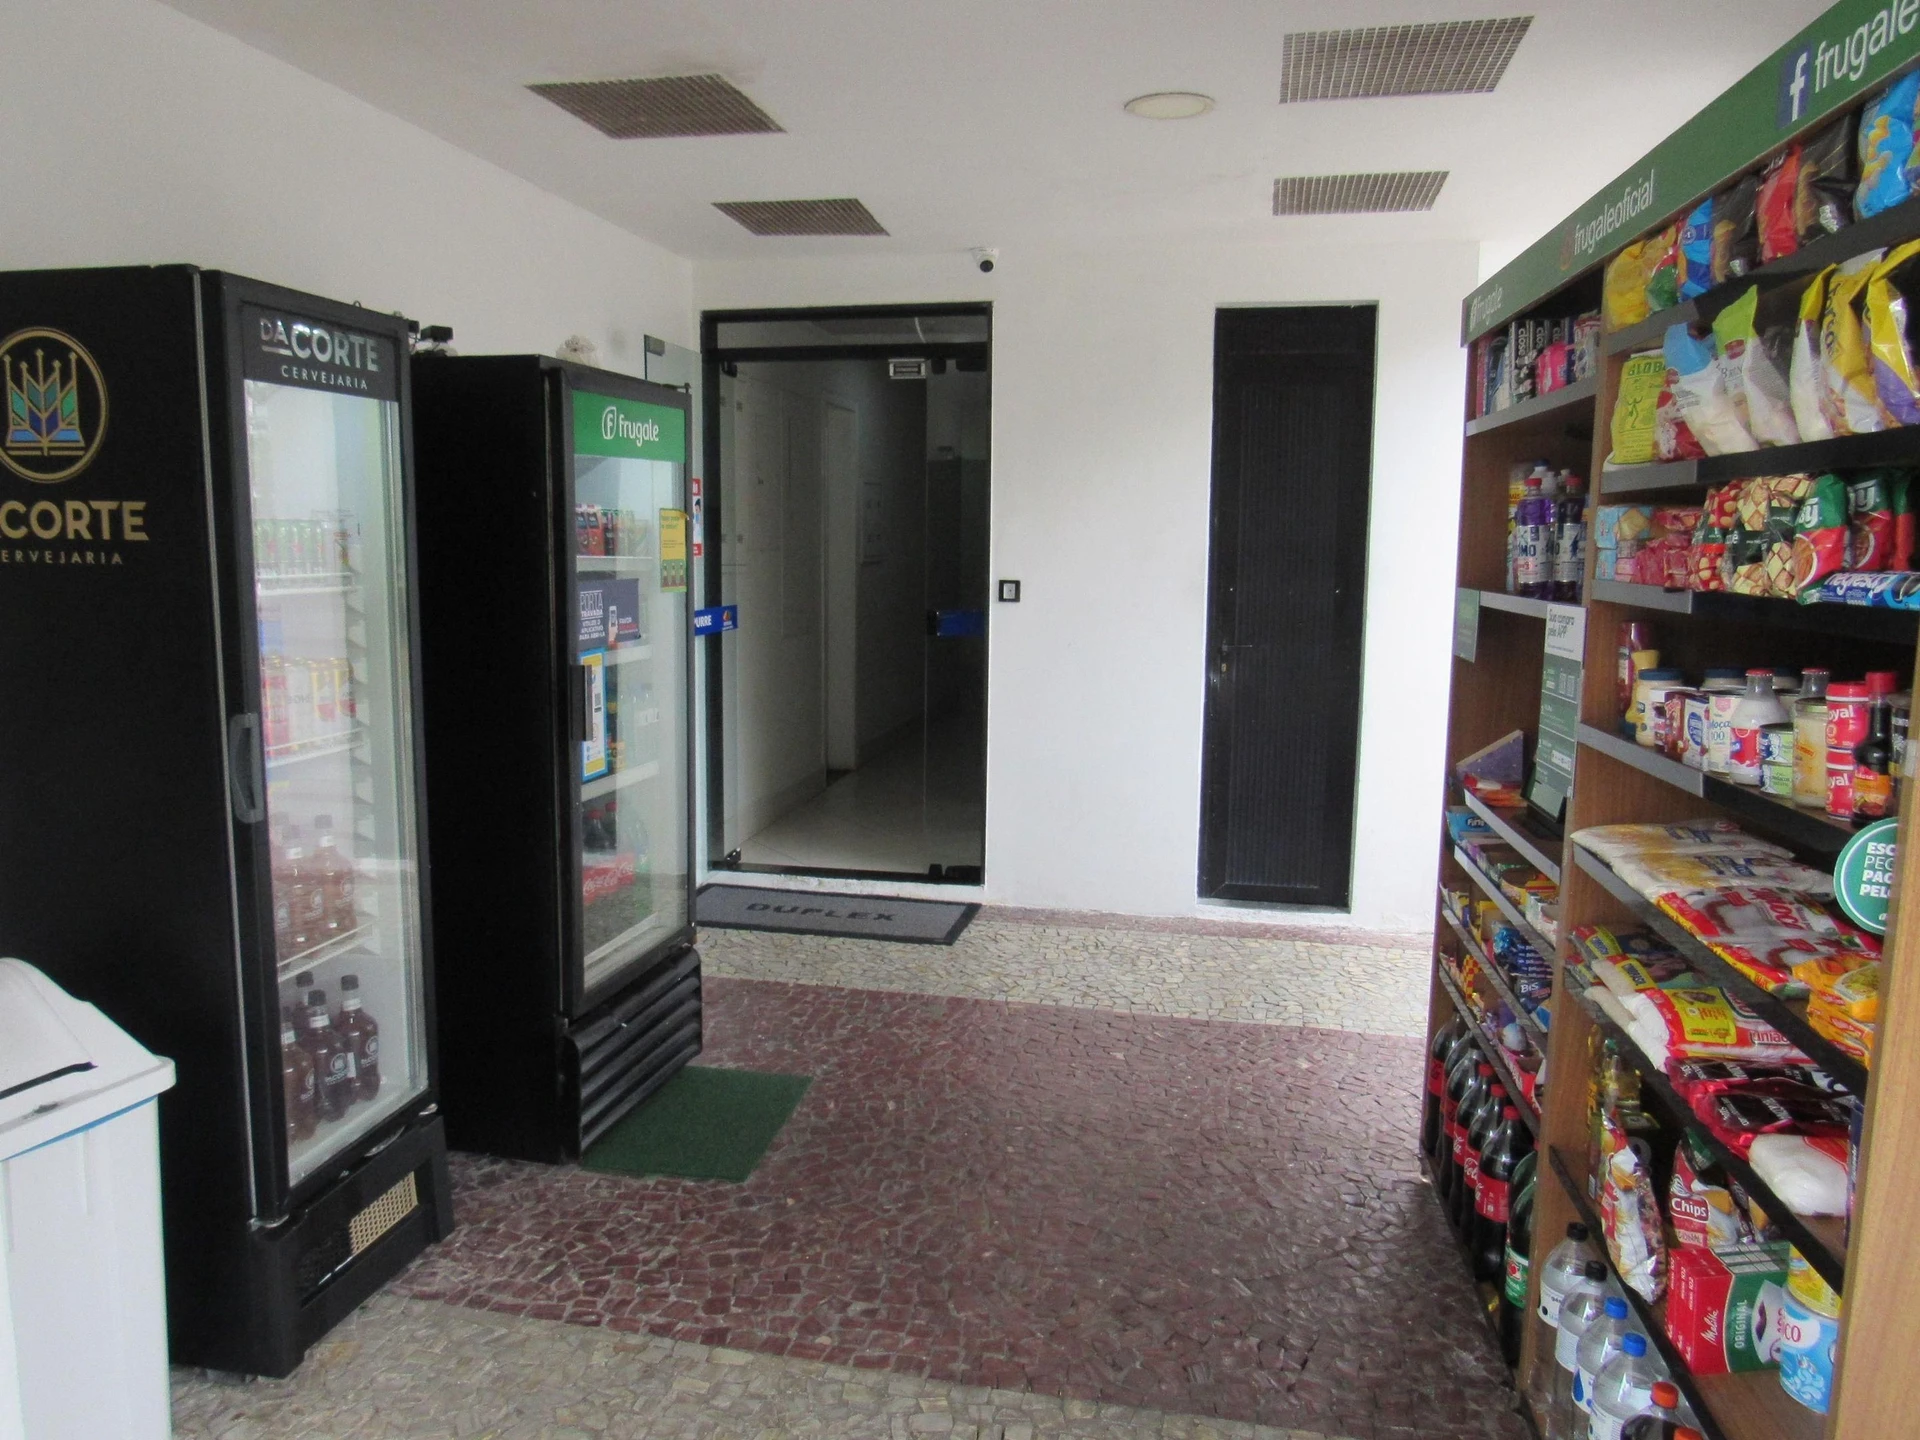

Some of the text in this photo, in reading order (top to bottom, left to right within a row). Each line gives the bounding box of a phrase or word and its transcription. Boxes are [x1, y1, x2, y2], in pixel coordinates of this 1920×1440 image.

[1574, 168, 1654, 256] frugaleoficial
[281, 364, 368, 390] CERVEJARIA
[619, 414, 660, 447] frugale
[1859, 883, 1891, 899] PEL
[1671, 1198, 1708, 1218] Chips
[1734, 1300, 1748, 1349] ORIGINAL
